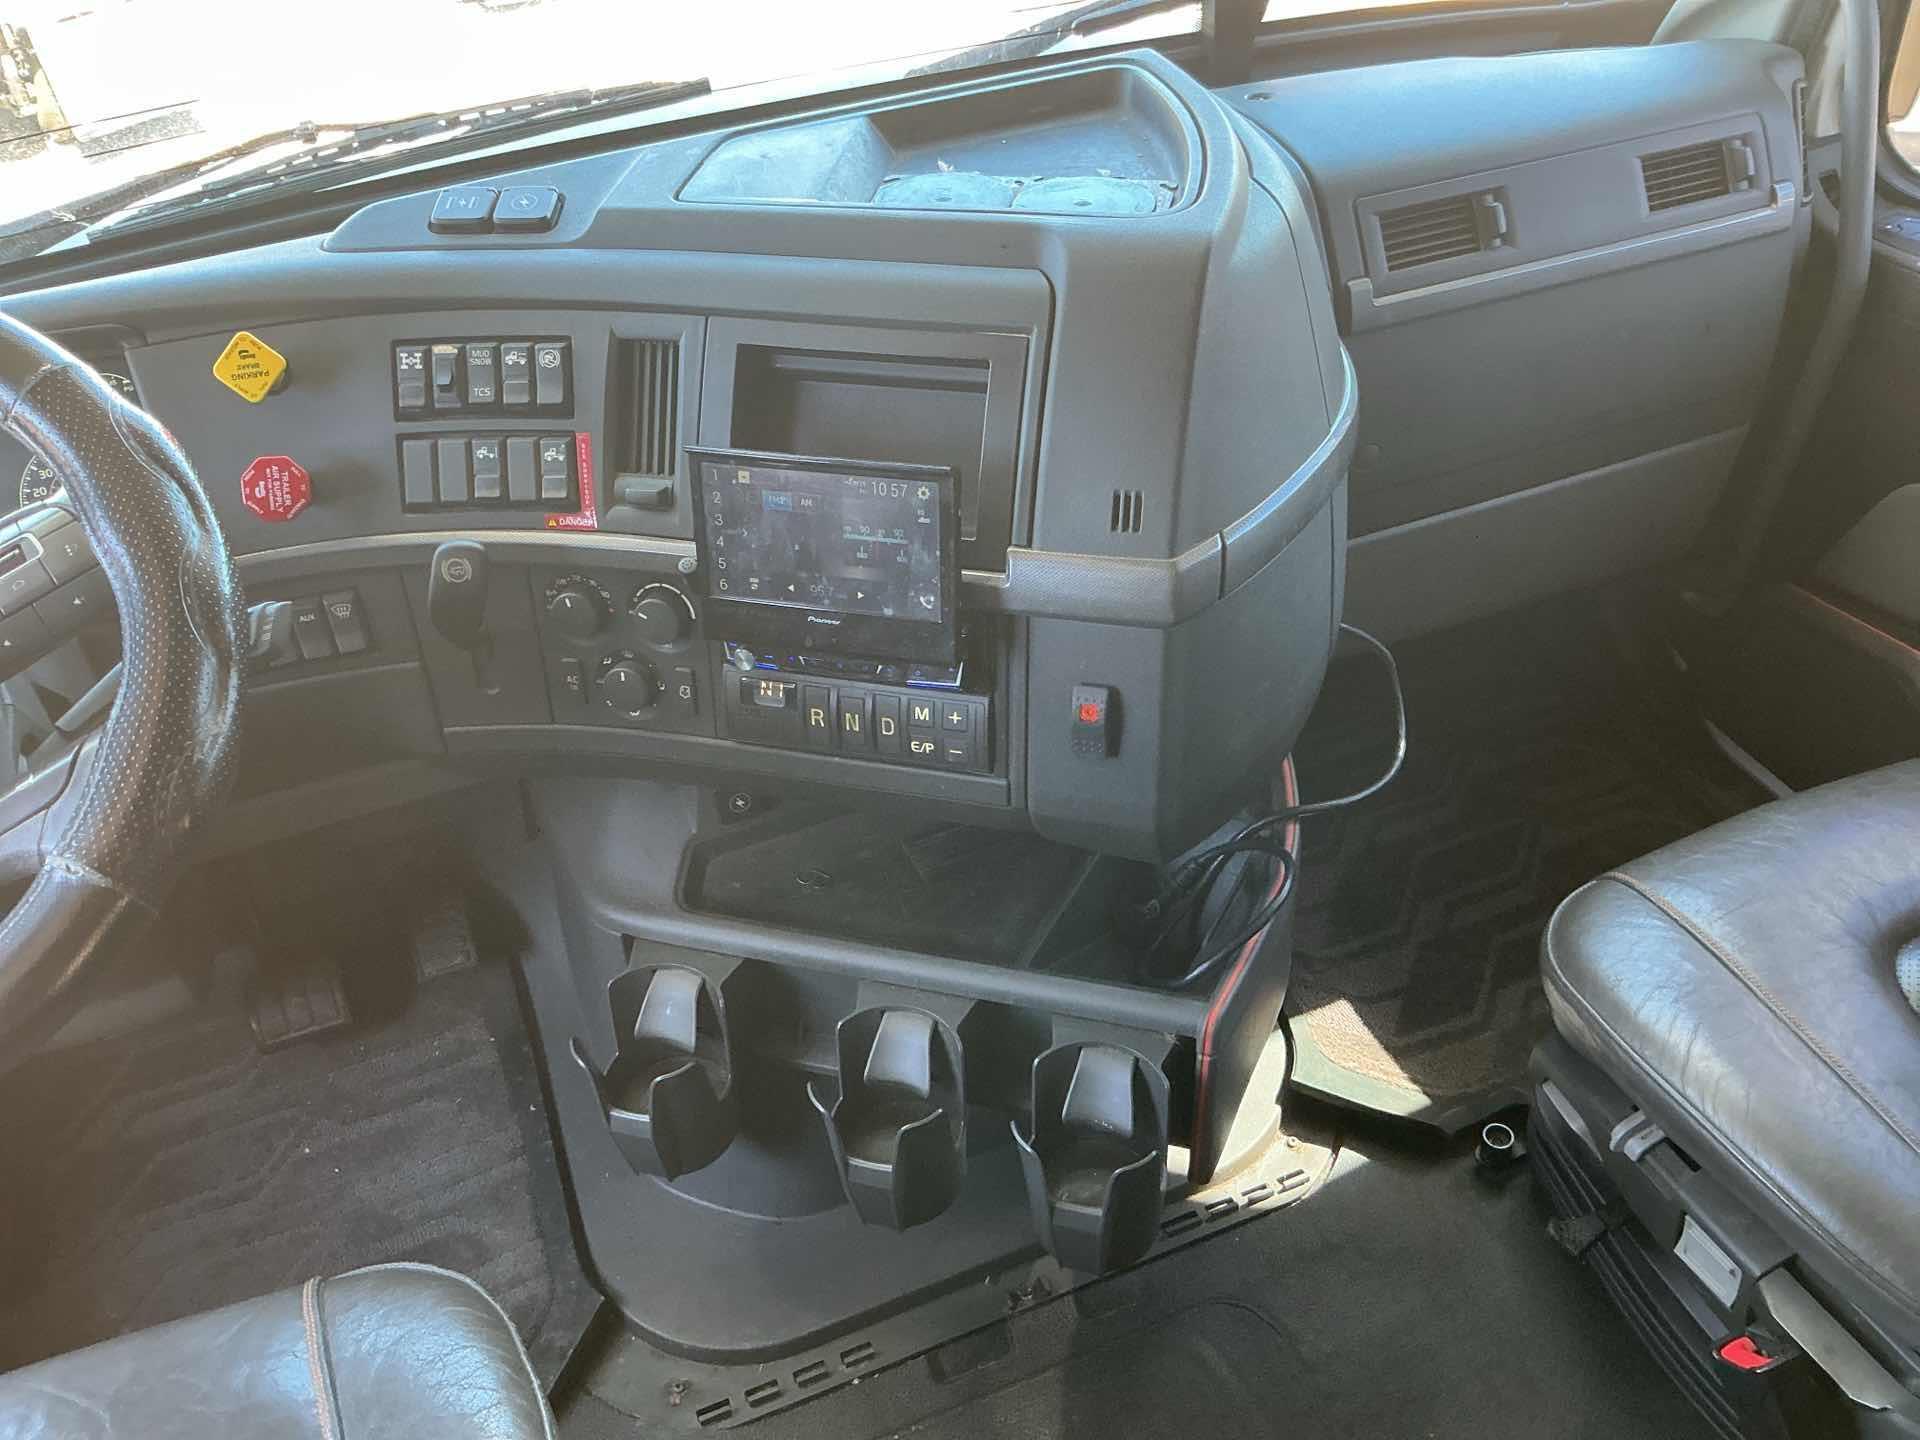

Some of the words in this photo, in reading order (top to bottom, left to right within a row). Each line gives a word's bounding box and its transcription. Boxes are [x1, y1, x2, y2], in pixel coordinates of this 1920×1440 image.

[471, 350, 490, 358] MUD
[470, 358, 493, 366] SNOW
[474, 387, 491, 397] TCS
[38, 468, 53, 480] 30
[271, 465, 280, 479] AIR
[32, 486, 48, 498] 20
[281, 471, 292, 506] TRAILER
[273, 480, 284, 513] SUPPLY
[712, 491, 721, 504] 2
[714, 513, 724, 526] 3
[716, 535, 724, 548] 4
[718, 557, 727, 569] 5
[719, 578, 729, 591] 6
[807, 616, 841, 625] Pioneer
[914, 706, 930, 721] M
[810, 708, 825, 727] R
[845, 712, 860, 732] N
[881, 717, 895, 736] D
[911, 741, 935, 754] E/P
